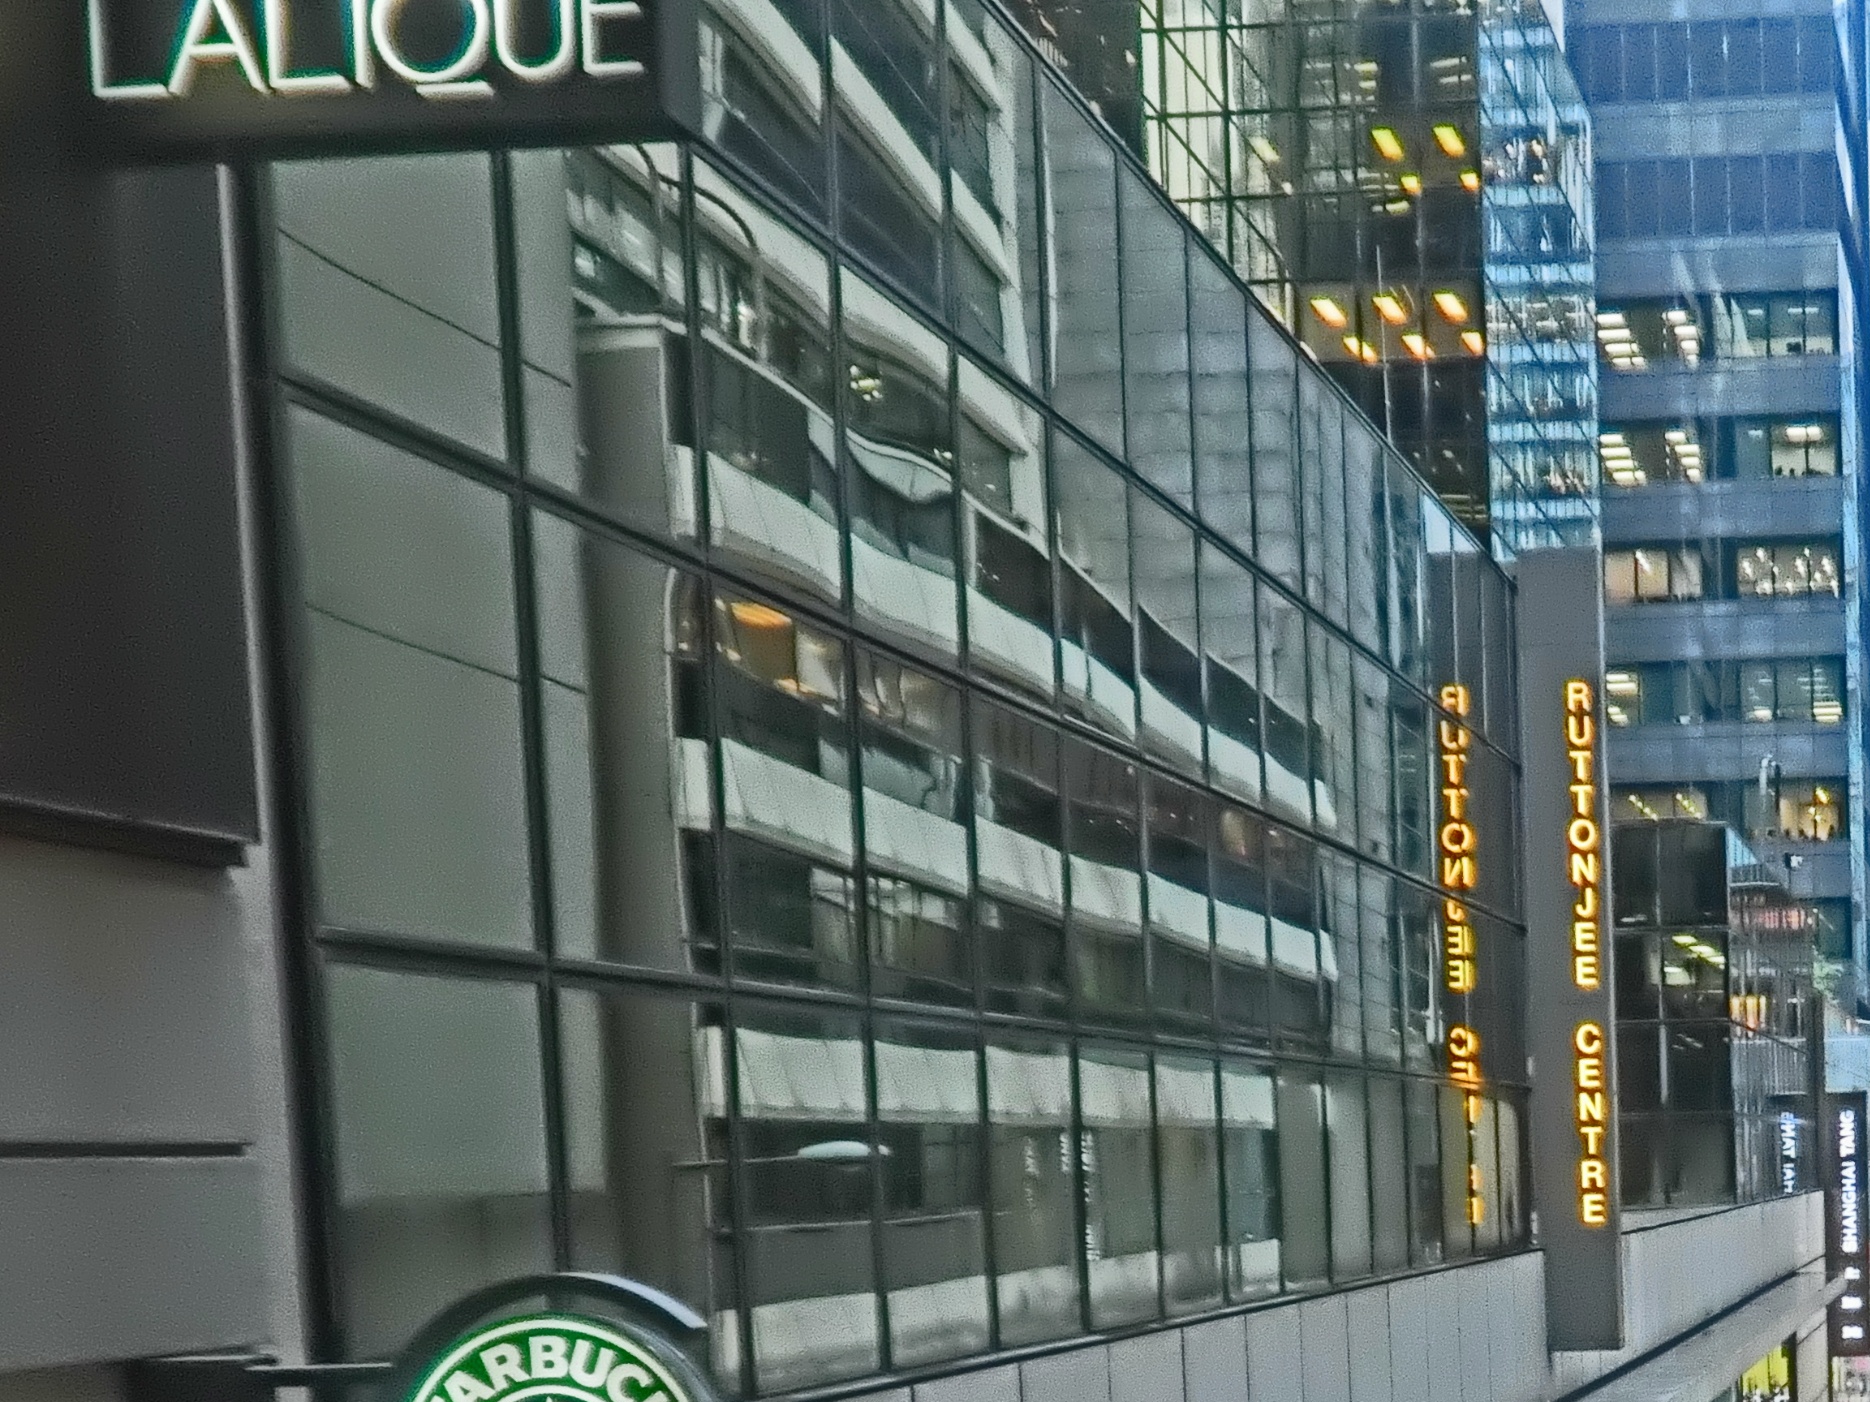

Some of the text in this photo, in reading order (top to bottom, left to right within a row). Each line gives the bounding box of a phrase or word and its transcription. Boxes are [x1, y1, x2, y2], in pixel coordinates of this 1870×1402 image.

[88, 0, 647, 99] LALIQUE
[1566, 681, 1606, 1224] RUTTONJEE CENTRE
[1840, 1110, 1856, 1159] TANG
[1841, 1160, 1859, 1253] SHANGHAI
